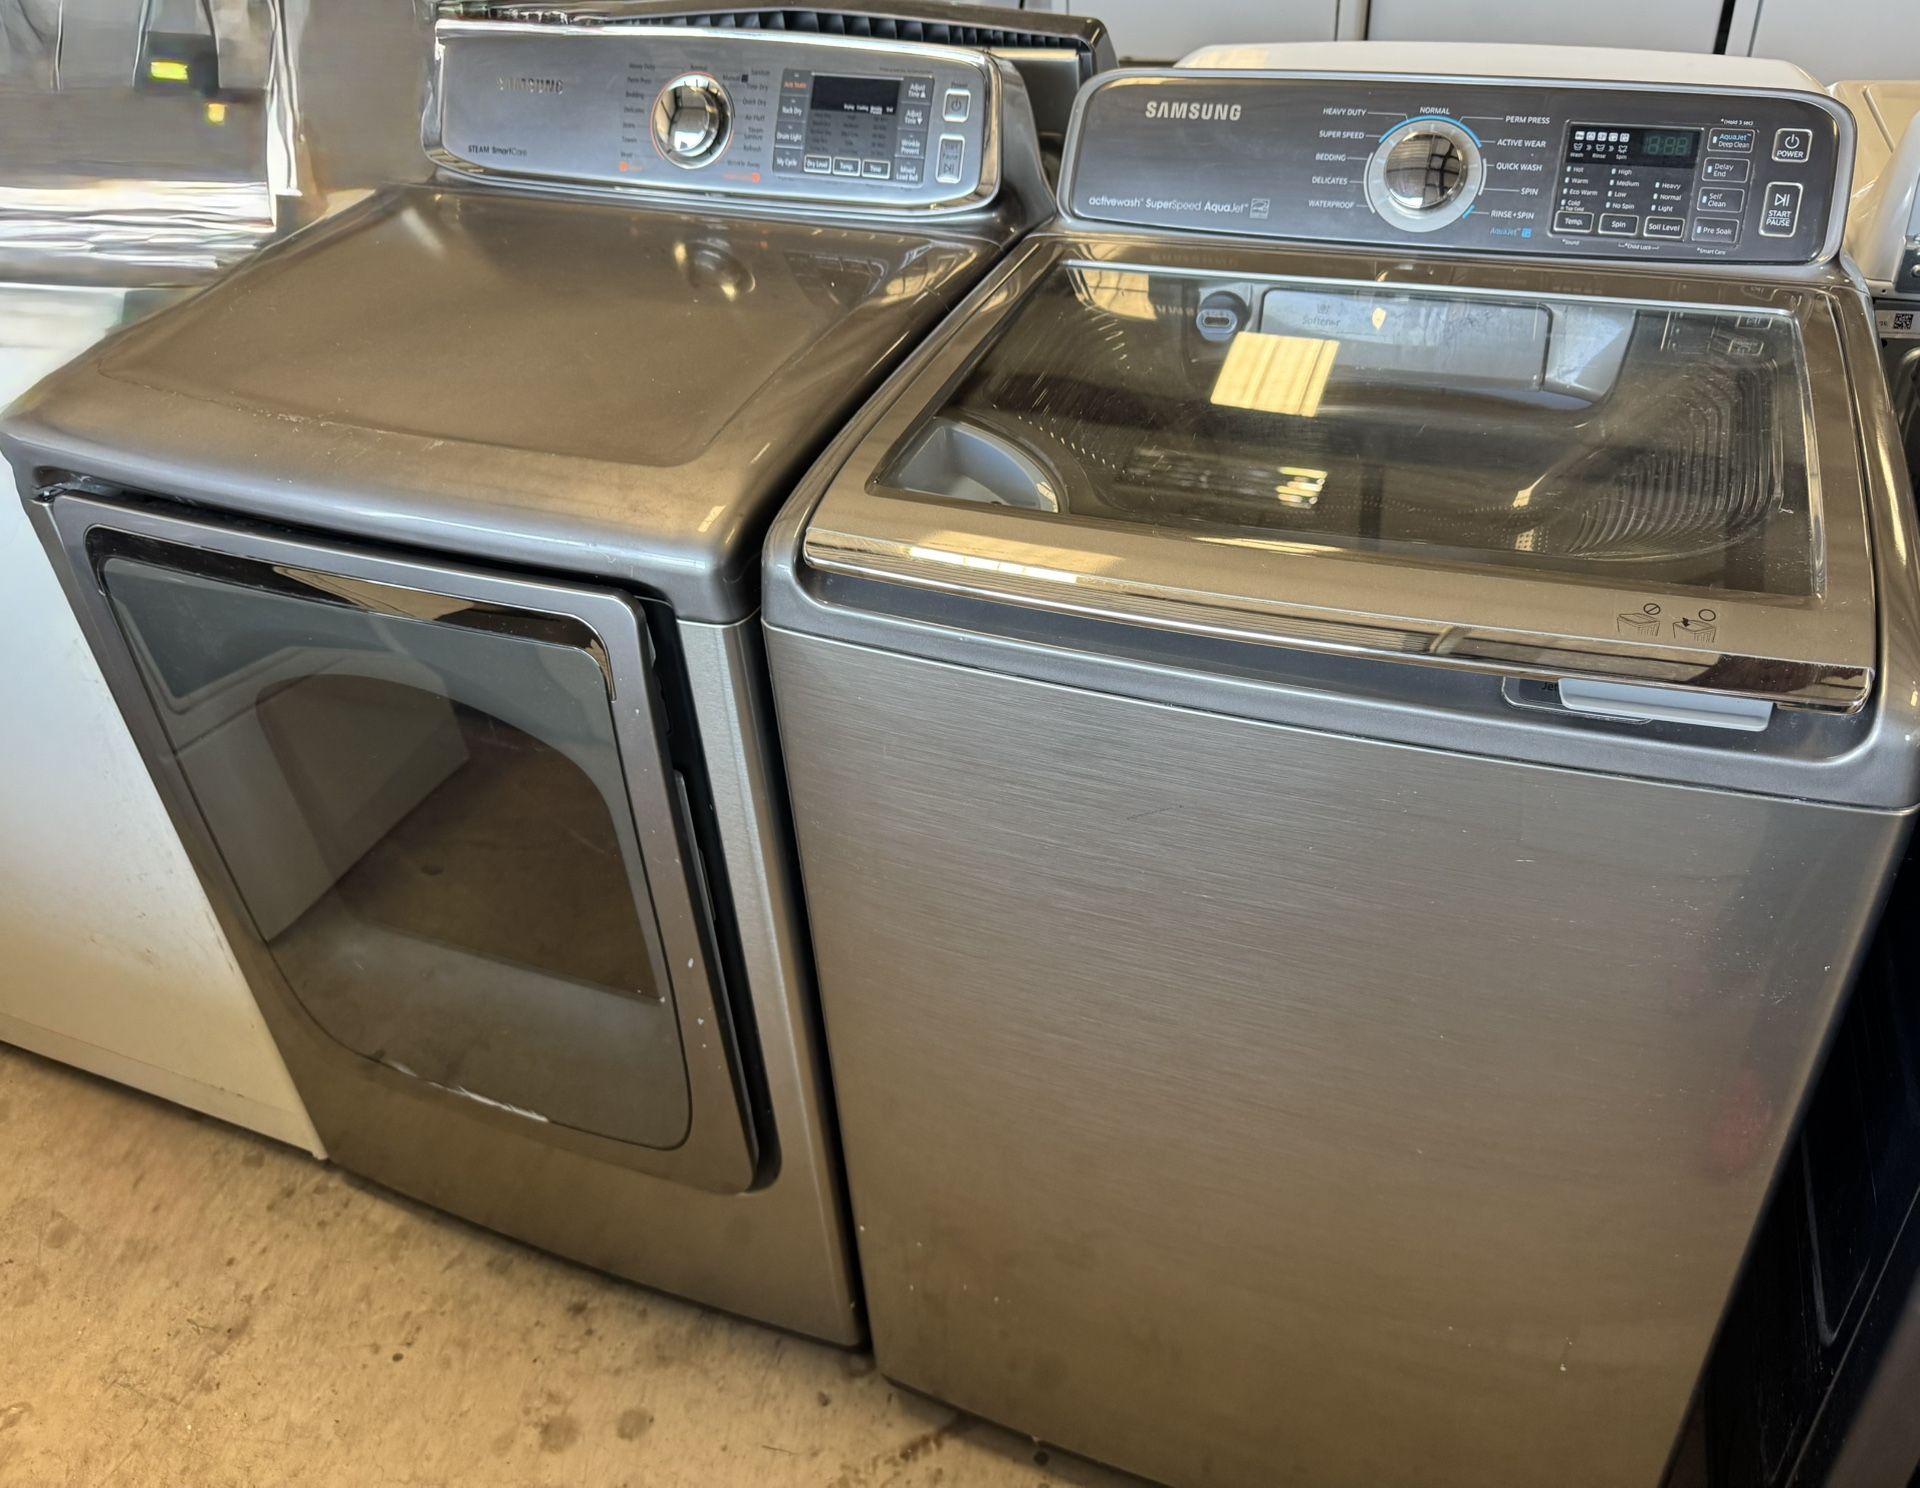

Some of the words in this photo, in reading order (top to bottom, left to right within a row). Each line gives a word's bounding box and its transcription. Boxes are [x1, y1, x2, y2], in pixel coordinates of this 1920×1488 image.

[1145, 101, 1242, 121] SAMSUNG
[1322, 108, 1346, 116] HEAVY
[1347, 108, 1367, 117] DUTY
[1419, 106, 1450, 115] NORMAL
[1505, 115, 1527, 123] PERM
[1528, 116, 1550, 125] PRESS
[1319, 130, 1341, 138] SUPER
[1342, 130, 1364, 139] SPEED
[1497, 138, 1522, 147] ACTIVE
[1524, 139, 1546, 148] WEAR
[468, 145, 490, 153] STEAM
[1315, 152, 1346, 161] BEDDING
[1777, 150, 1803, 158] POWER
[807, 159, 815, 168] Dry
[1496, 162, 1519, 170] QUICK
[1520, 163, 1542, 172] WASH
[1715, 163, 1734, 172] Delay
[1312, 176, 1347, 185] DELICATES
[1521, 187, 1539, 195] SPIN
[1708, 192, 1722, 200] Self
[1145, 197, 1201, 211] SuperSpeed
[1308, 199, 1354, 209] WATERPROOF
[1708, 200, 1726, 208] Clean
[1611, 220, 1626, 228] Spin
[1766, 218, 1790, 226] PAUSE
[1649, 222, 1661, 230] Soil
[1662, 223, 1681, 232] Level
[1715, 227, 1732, 235] Soak
